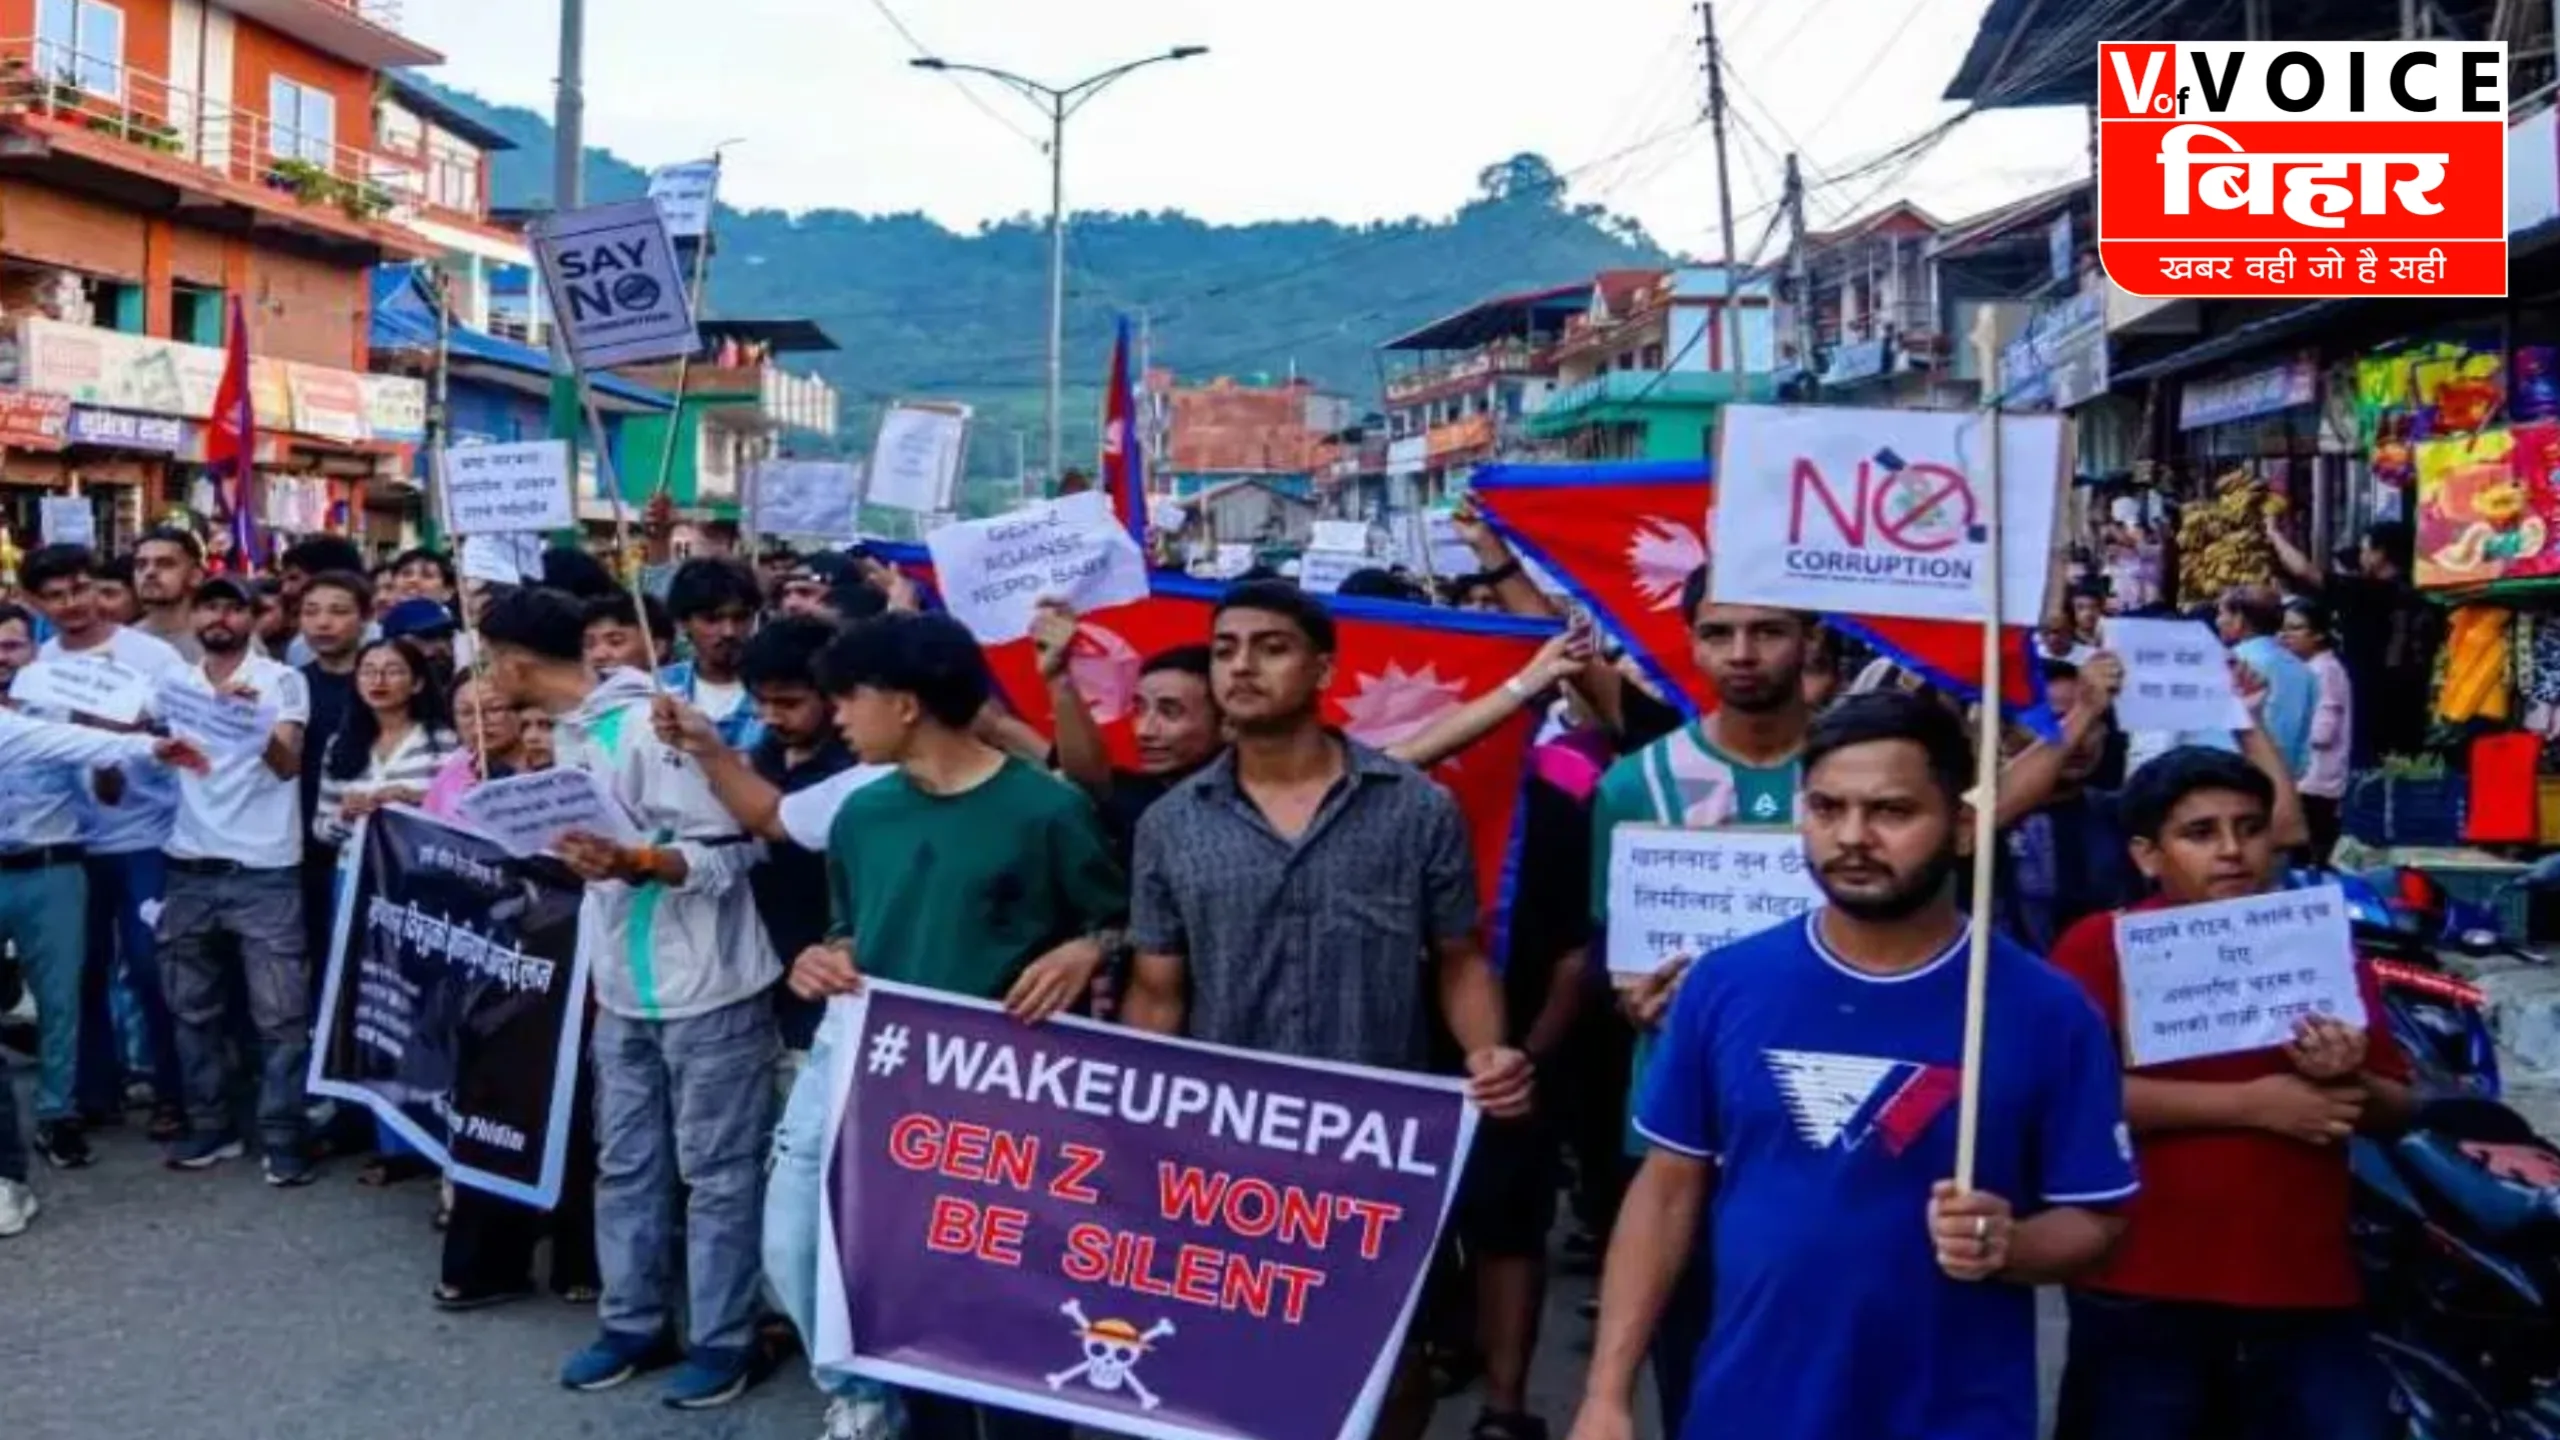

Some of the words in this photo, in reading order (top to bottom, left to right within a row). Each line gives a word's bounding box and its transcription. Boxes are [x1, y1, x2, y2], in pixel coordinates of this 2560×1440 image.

[558, 238, 647, 279] SAY
[566, 272, 661, 322] NO
[1788, 456, 1977, 553] NO
[984, 532, 1083, 571] AGAINST
[1786, 550, 1972, 580] CORRUPTION
[868, 1023, 910, 1076] #
[925, 1032, 1439, 1177] WAKEUPNEPAL
[890, 1113, 1039, 1192] GEN
[1050, 1144, 1104, 1204] Z
[1158, 1161, 1401, 1260] WON'T
[928, 1197, 1029, 1265] BE
[1062, 1224, 1325, 1324] SILENT
